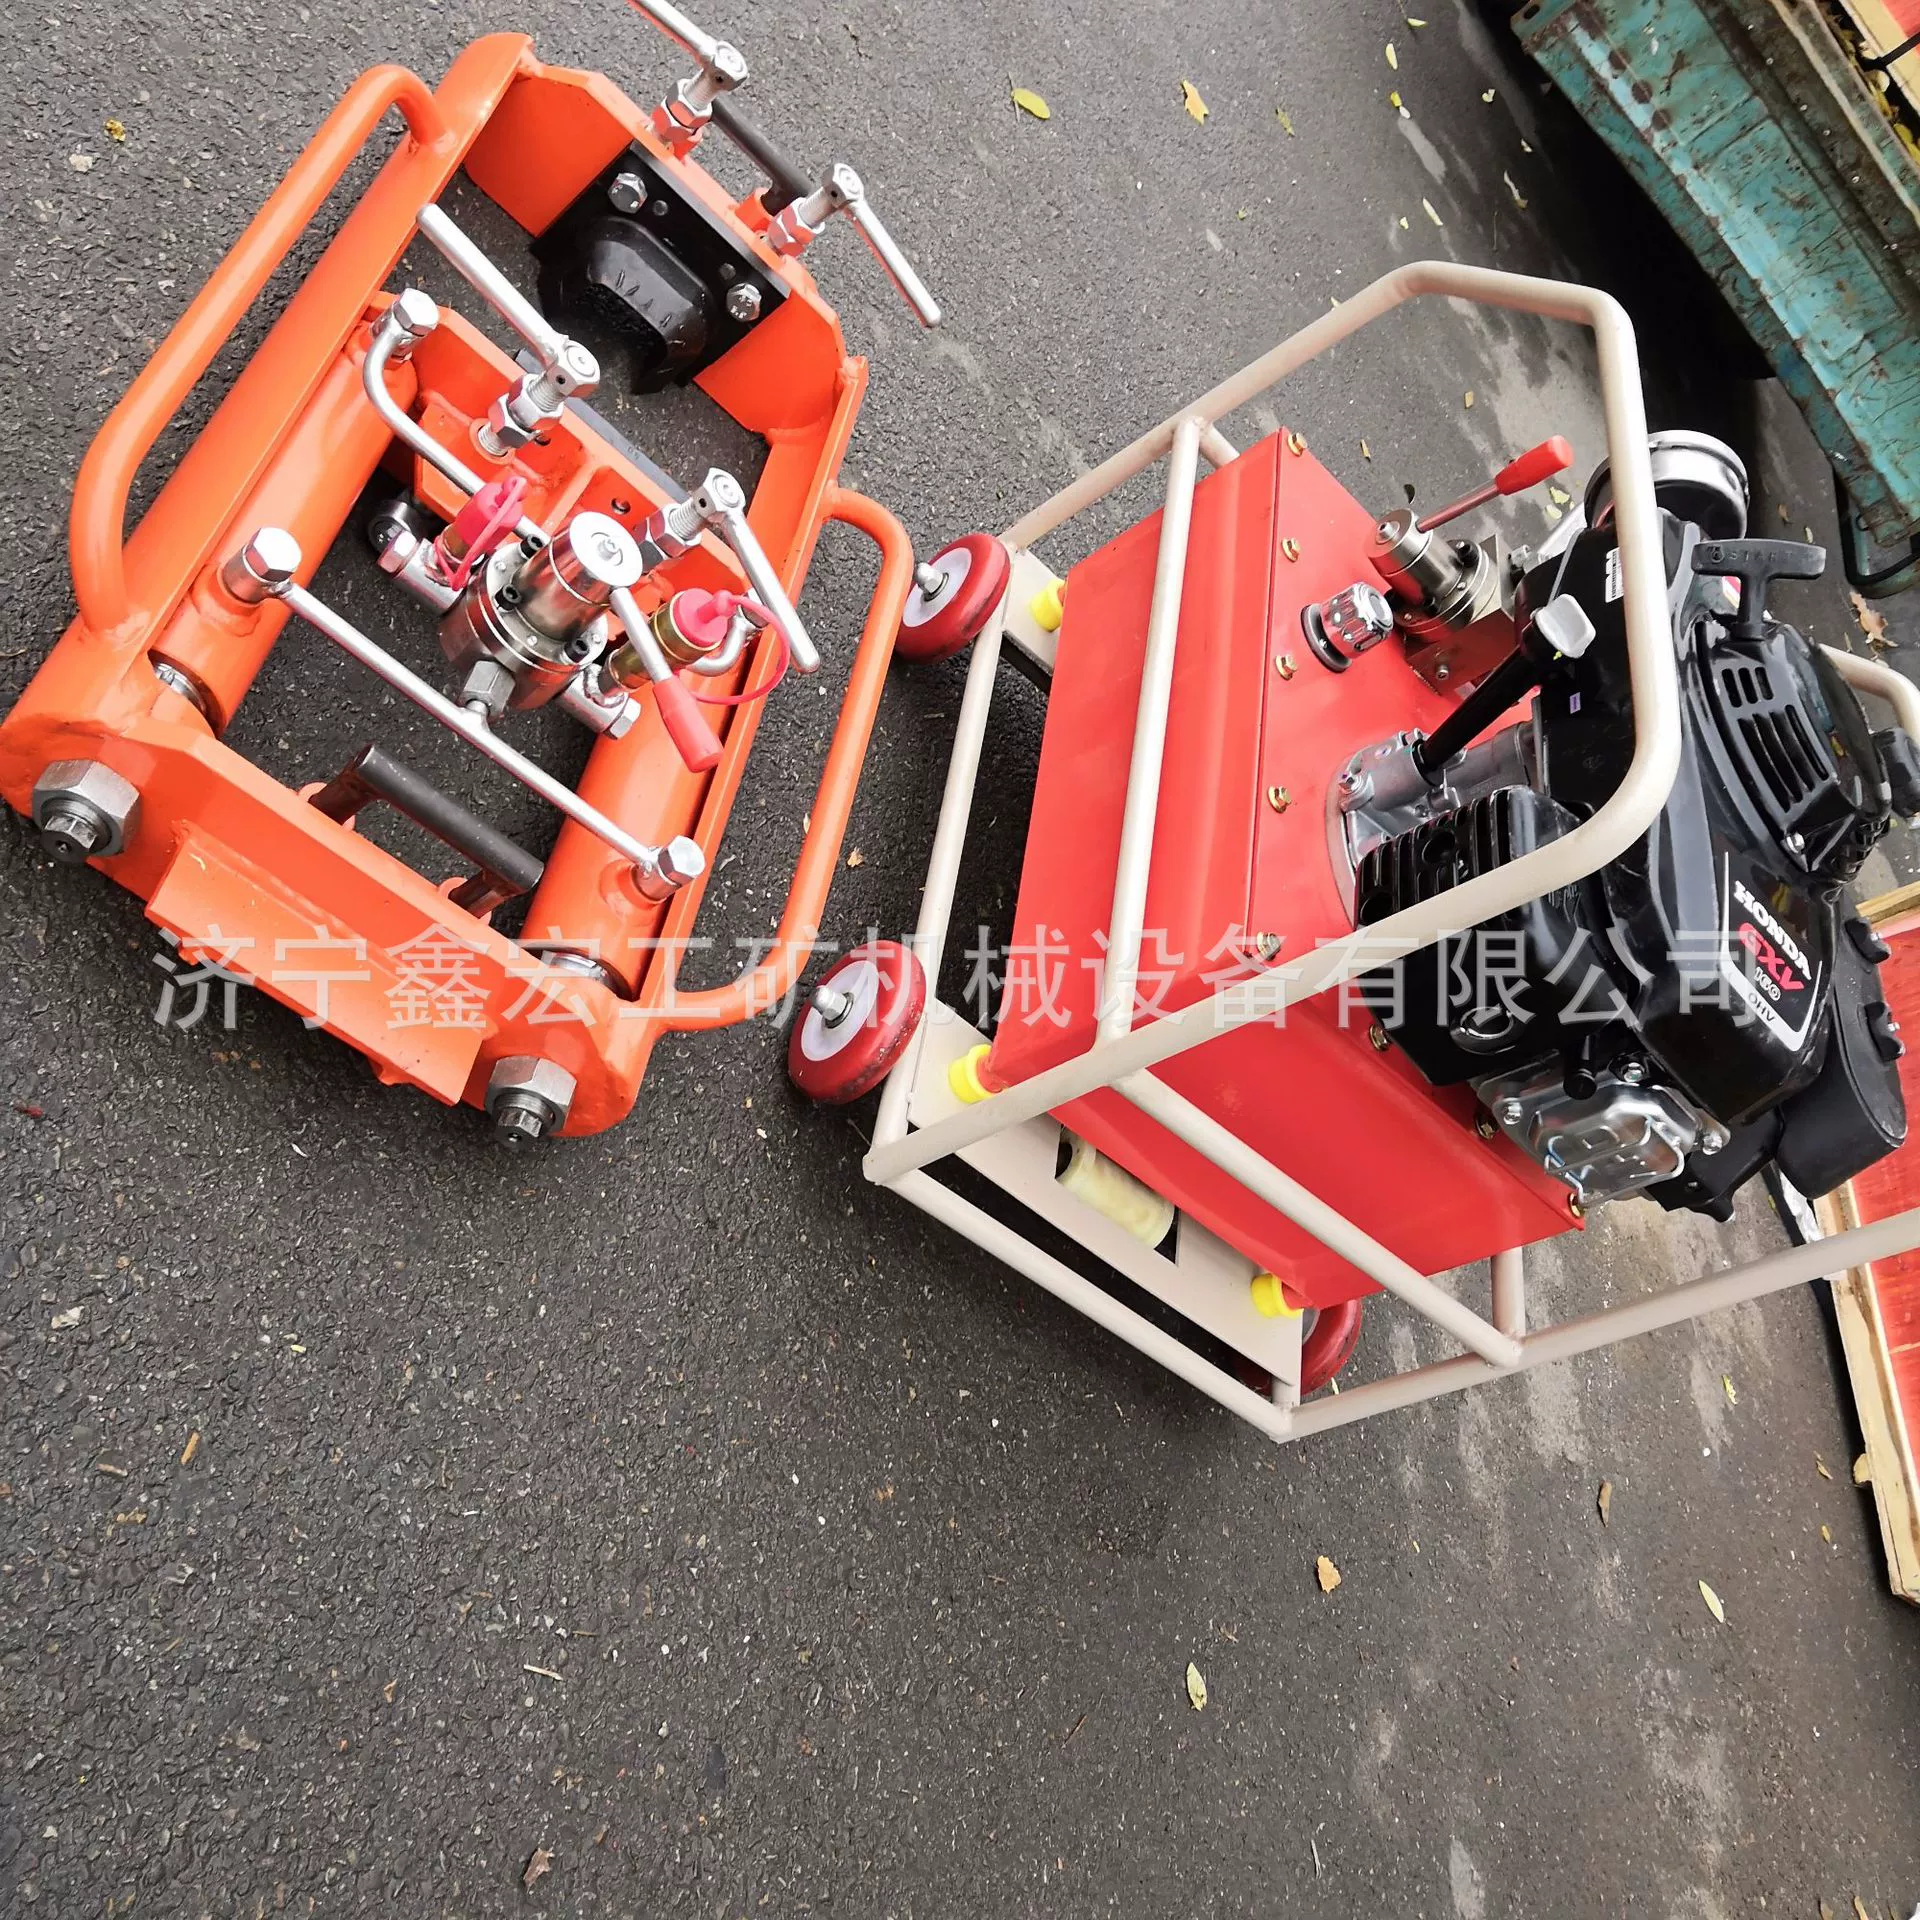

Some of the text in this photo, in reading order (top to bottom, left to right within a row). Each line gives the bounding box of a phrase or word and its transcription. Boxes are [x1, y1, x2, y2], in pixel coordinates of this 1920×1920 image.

[1733, 880, 1812, 981] HONDA
[1738, 922, 1805, 990] GXV
[1747, 992, 1776, 1022] OHV
